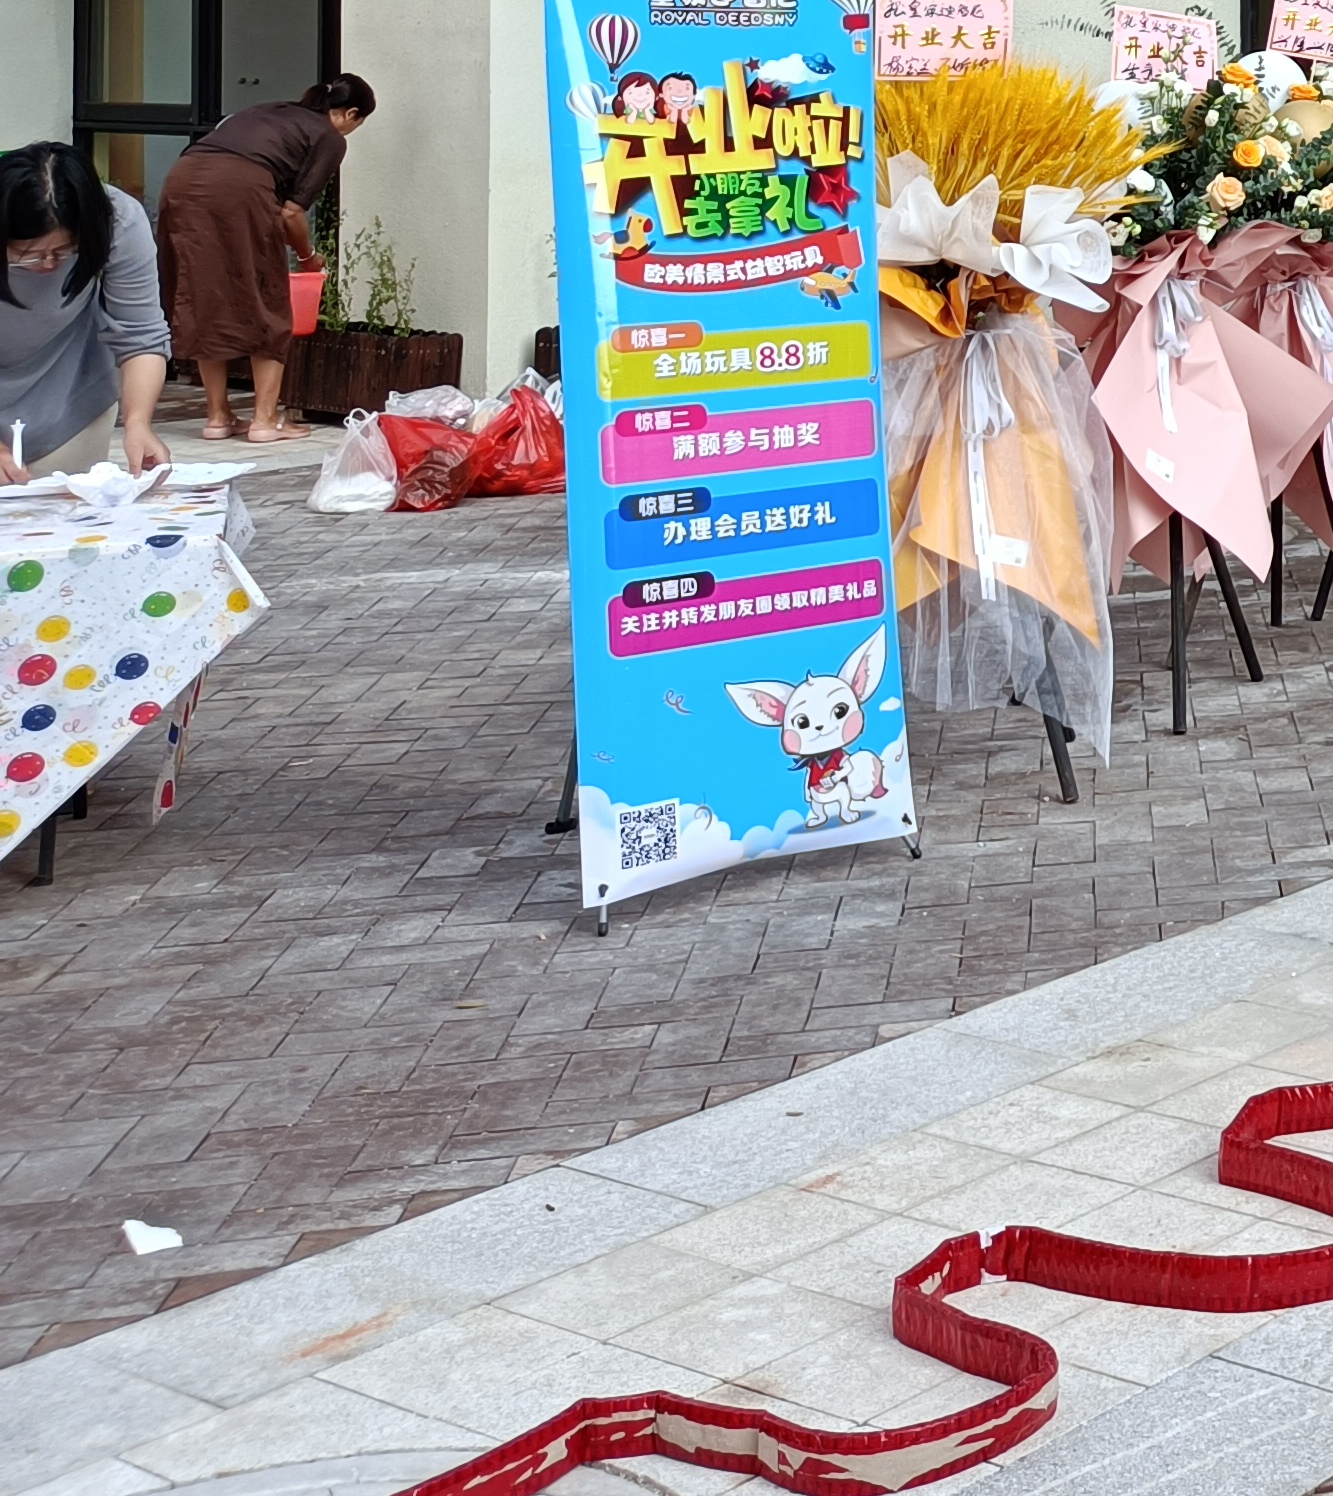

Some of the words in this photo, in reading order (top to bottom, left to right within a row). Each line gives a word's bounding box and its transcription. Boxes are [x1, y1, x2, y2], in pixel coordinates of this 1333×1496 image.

[650, 11, 710, 25] ROYAL
[887, 23, 1001, 51] 开业大吉
[1123, 35, 1209, 68] 开业大吉
[694, 173, 764, 196] 小朋友
[683, 174, 824, 237] 去拿礼
[643, 245, 824, 286] 欧美情景式益智玩具
[631, 328, 686, 349] 惊喜一
[653, 340, 830, 380] 全场玩具8.8折
[635, 411, 690, 432] 惊喜二
[672, 421, 821, 461] 满额参与抽奖
[638, 492, 694, 517] 惊喜三
[663, 501, 836, 546] 办理会员送好礼
[642, 578, 698, 602] 惊喜四
[619, 579, 877, 636] 关注并转发朋友圈领取精美礼品
